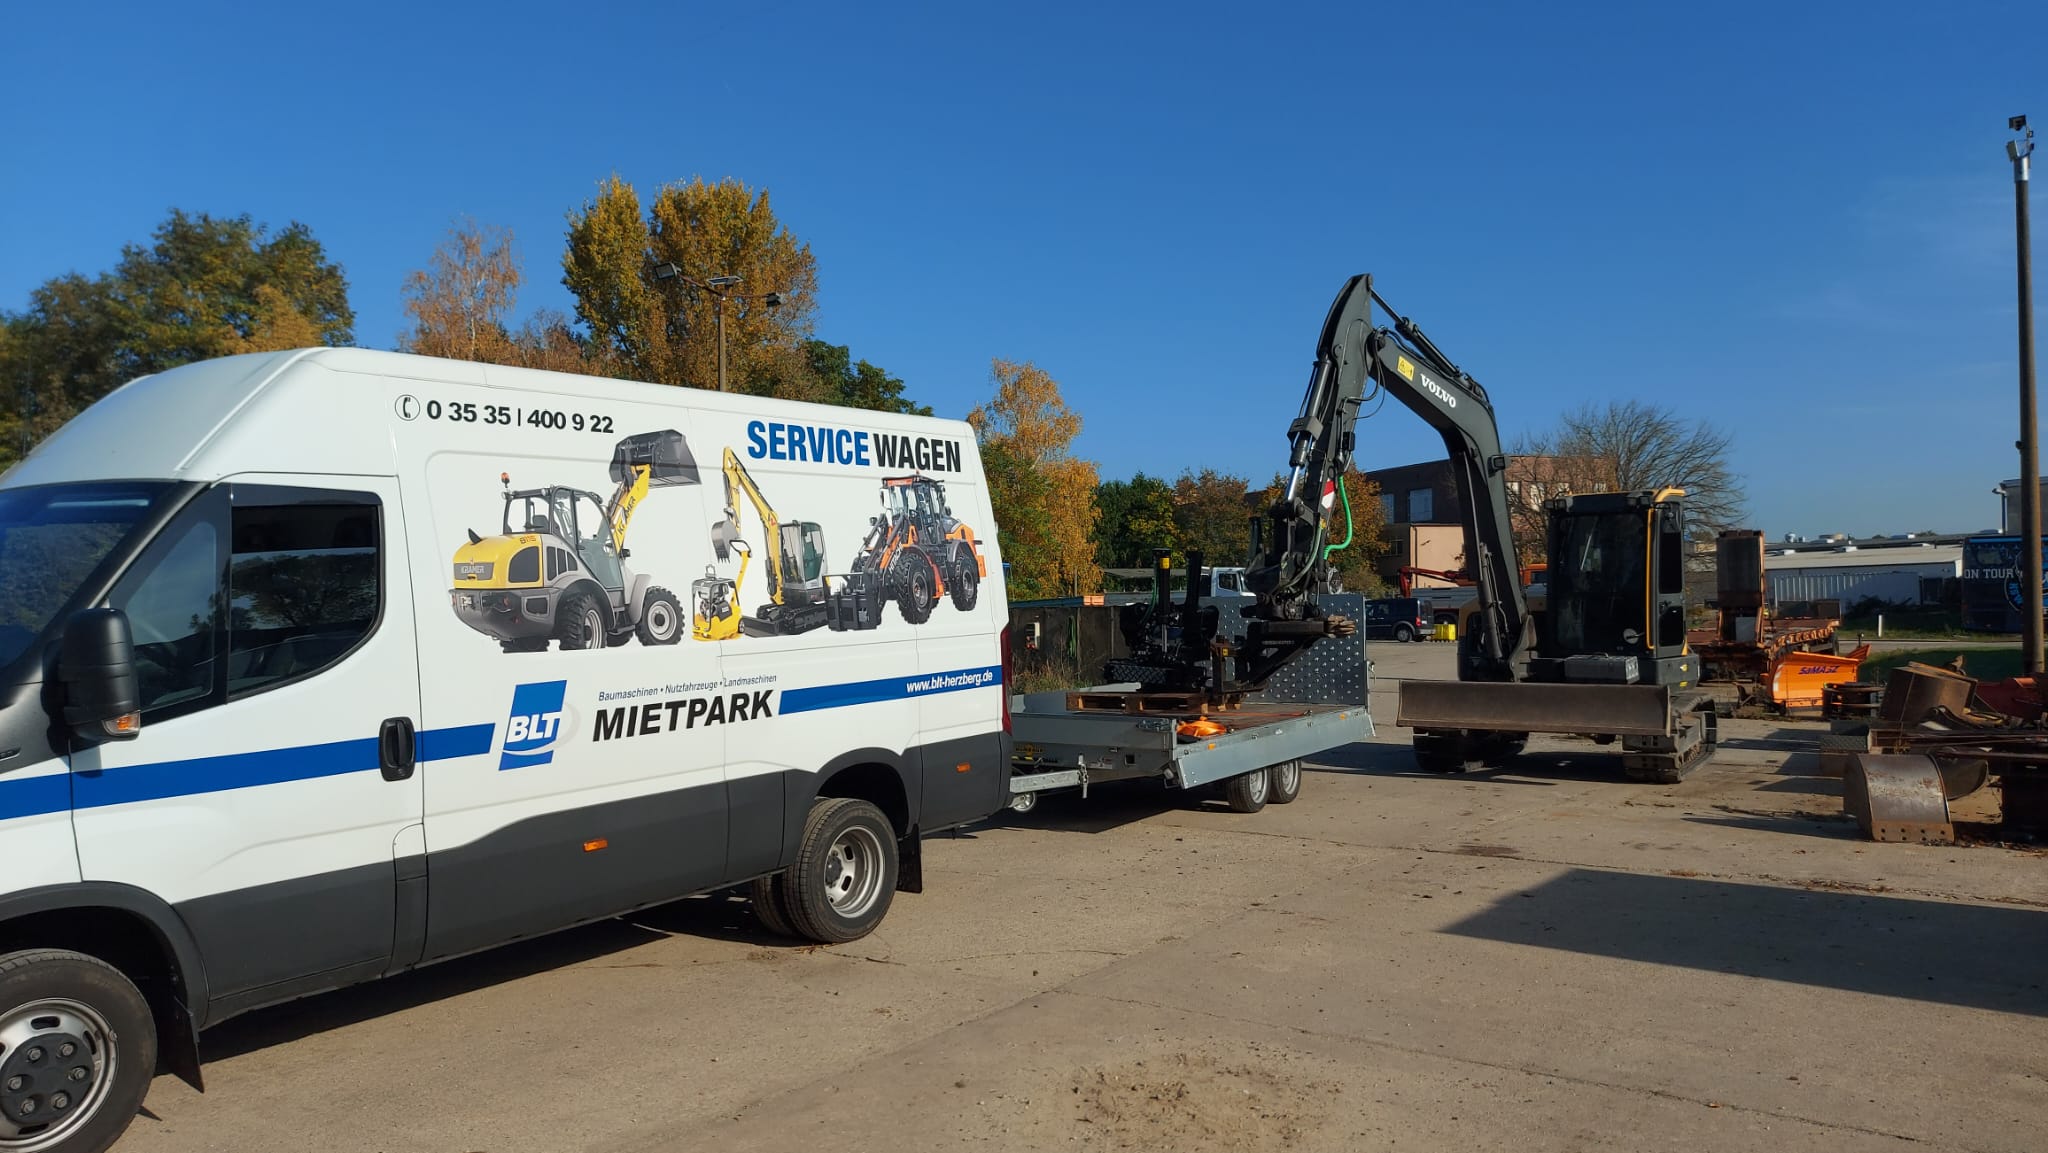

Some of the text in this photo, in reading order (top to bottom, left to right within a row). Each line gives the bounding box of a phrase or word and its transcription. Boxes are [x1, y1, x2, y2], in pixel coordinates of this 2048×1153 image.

[1420, 373, 1456, 408] VOLVO
[426, 400, 442, 419] 0
[447, 402, 477, 422] 35
[483, 405, 511, 425] 35
[527, 409, 567, 430] 400
[572, 413, 585, 431] 9
[590, 415, 614, 433] 22
[747, 420, 961, 472] SERVICE WAGEN
[1964, 568, 2014, 579] ON TOUR
[599, 674, 777, 701] Baumaschinen Nutzfahrzeuge Landmaschinen
[906, 669, 993, 693] www.blt-herzberg.de
[506, 711, 561, 743] BLT
[593, 690, 773, 742] MIETPARK
